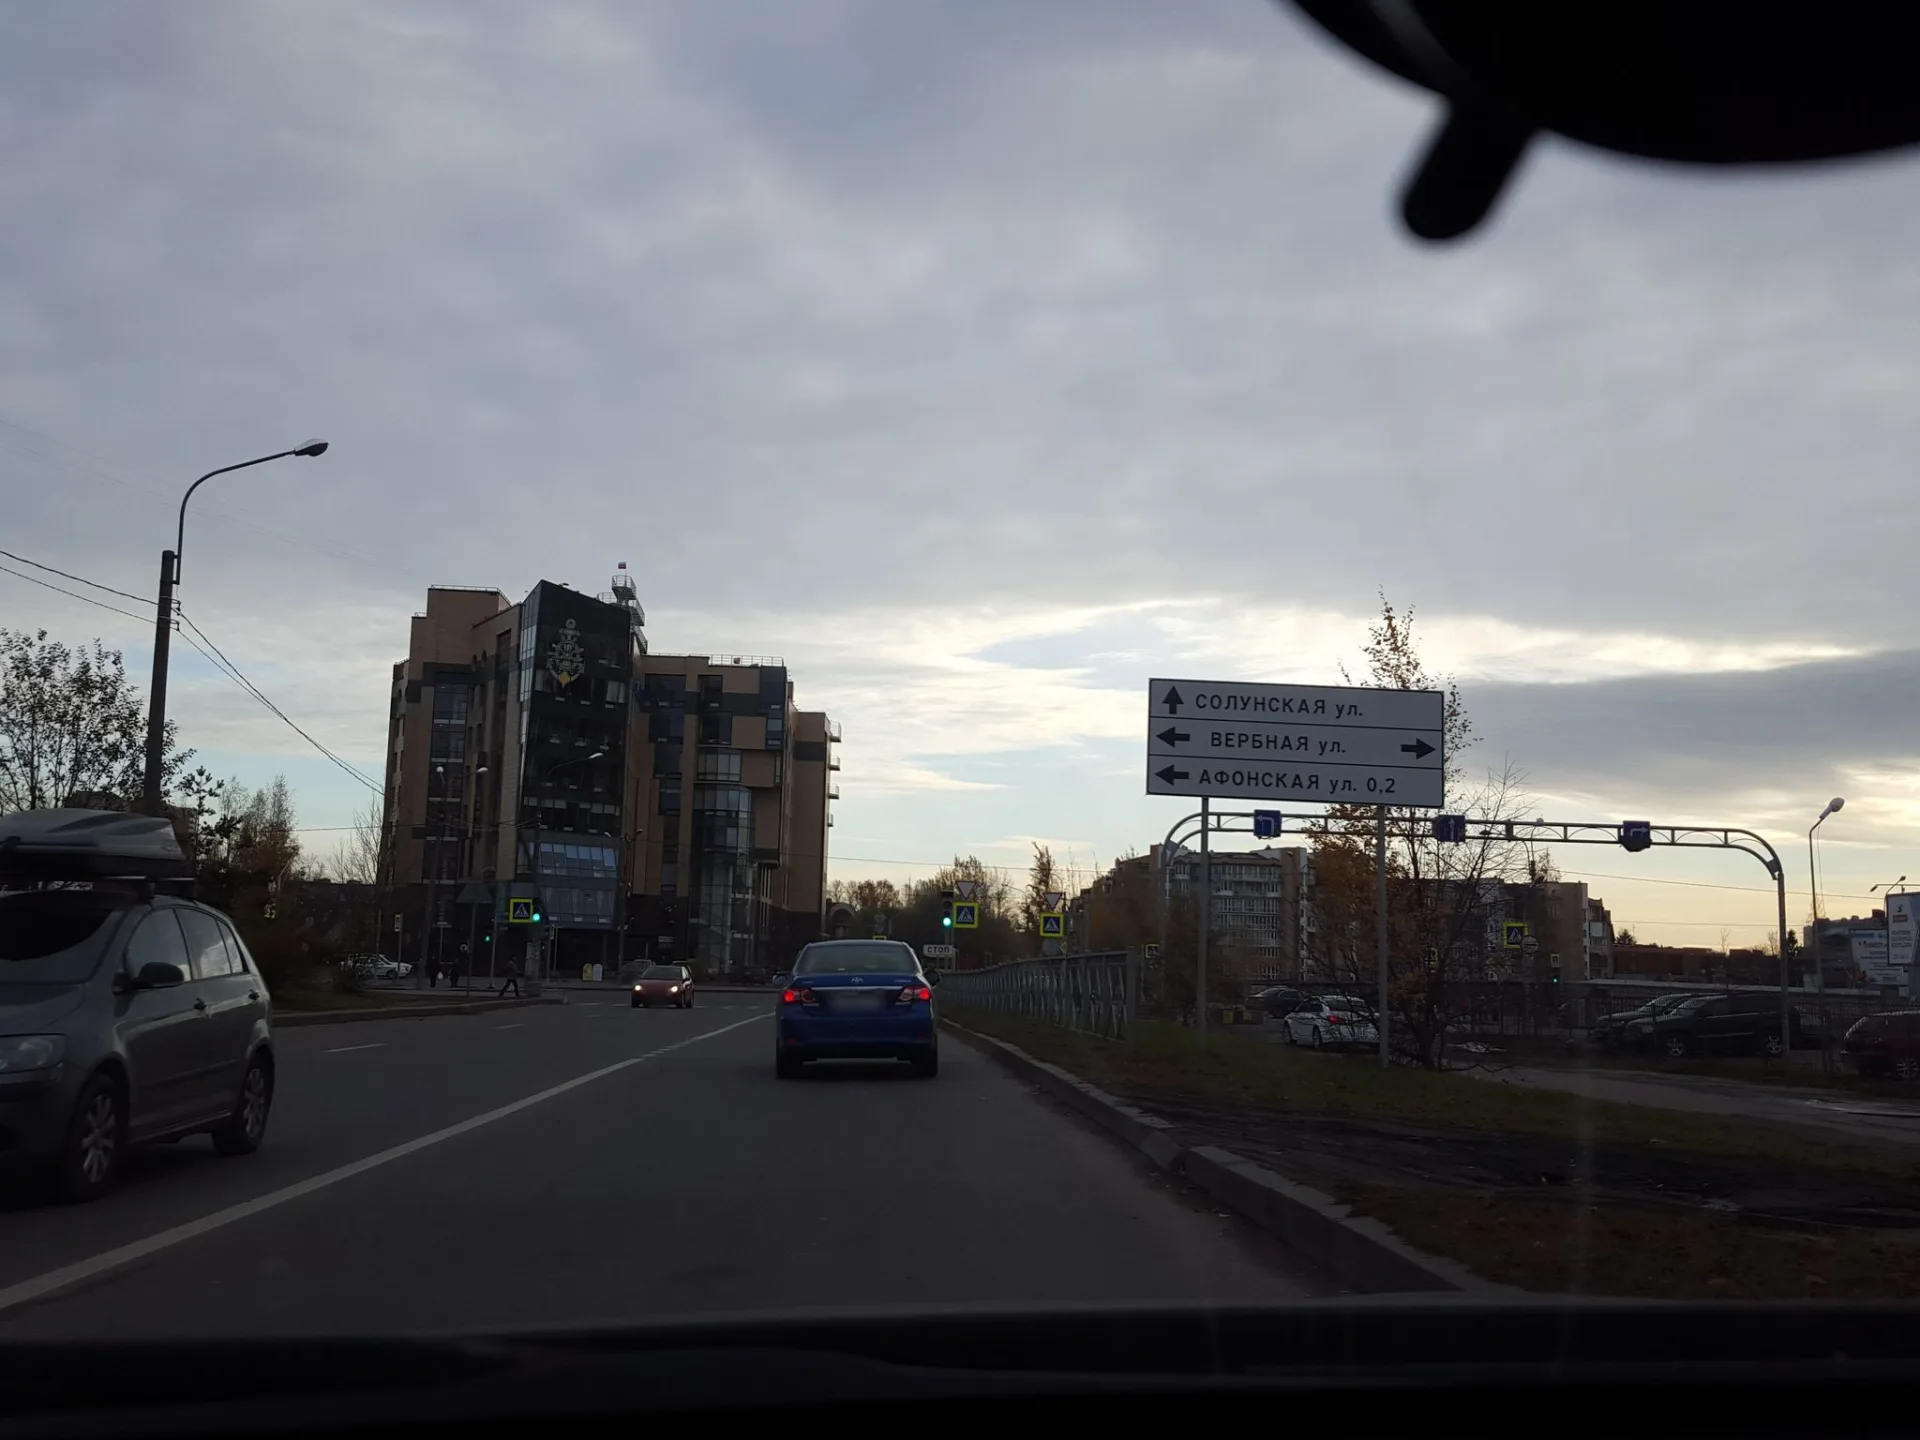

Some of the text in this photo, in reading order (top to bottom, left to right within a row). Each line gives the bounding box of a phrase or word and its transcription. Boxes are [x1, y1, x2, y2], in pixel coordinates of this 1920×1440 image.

[1195, 694, 1363, 719] СОЛУНСКАЯ ул.
[1211, 732, 1346, 755] ВЕРБНАЯ ул.
[1199, 769, 1396, 795] АФОНСКАЯ ул. 0,2
[927, 946, 950, 954] СТОП
